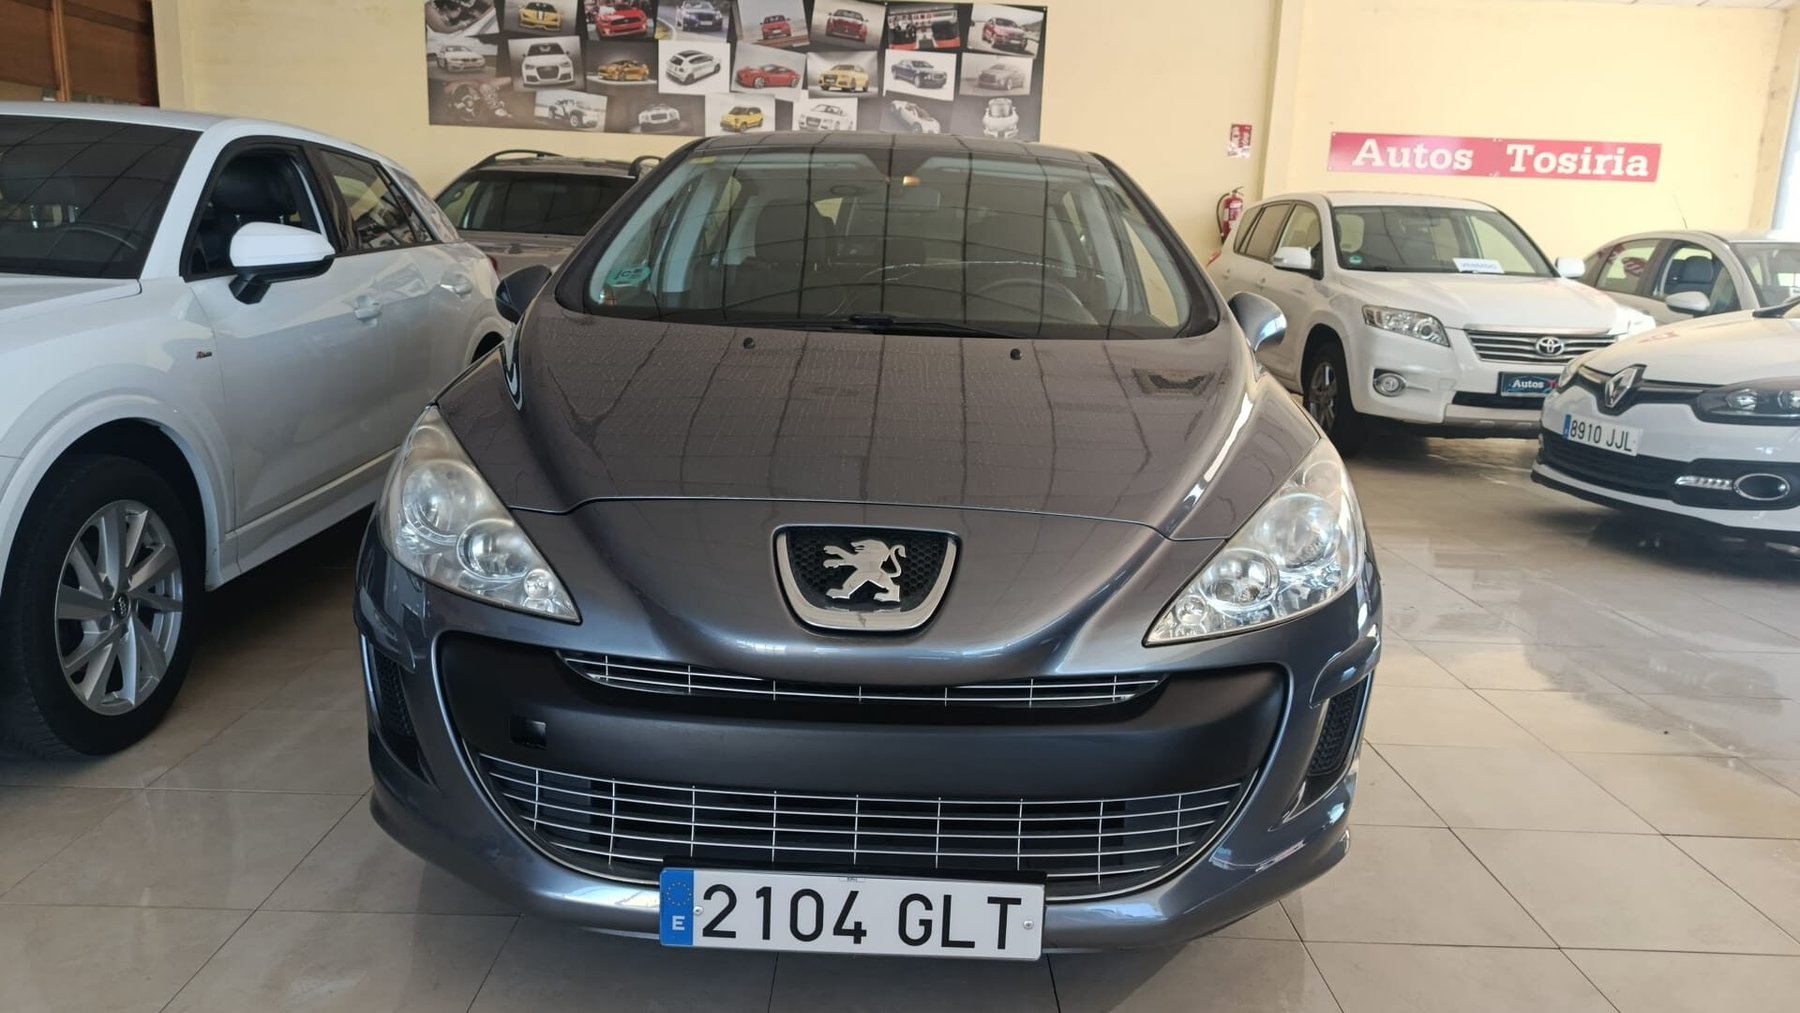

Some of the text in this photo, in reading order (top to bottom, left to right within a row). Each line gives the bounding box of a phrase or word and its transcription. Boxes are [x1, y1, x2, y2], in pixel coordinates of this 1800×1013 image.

[1351, 138, 1649, 178] Autos Tosiria
[1511, 379, 1545, 389] Autos
[1570, 419, 1633, 452] 8910 JJL
[671, 915, 685, 931] E
[702, 883, 1022, 950] 2104 GLT
